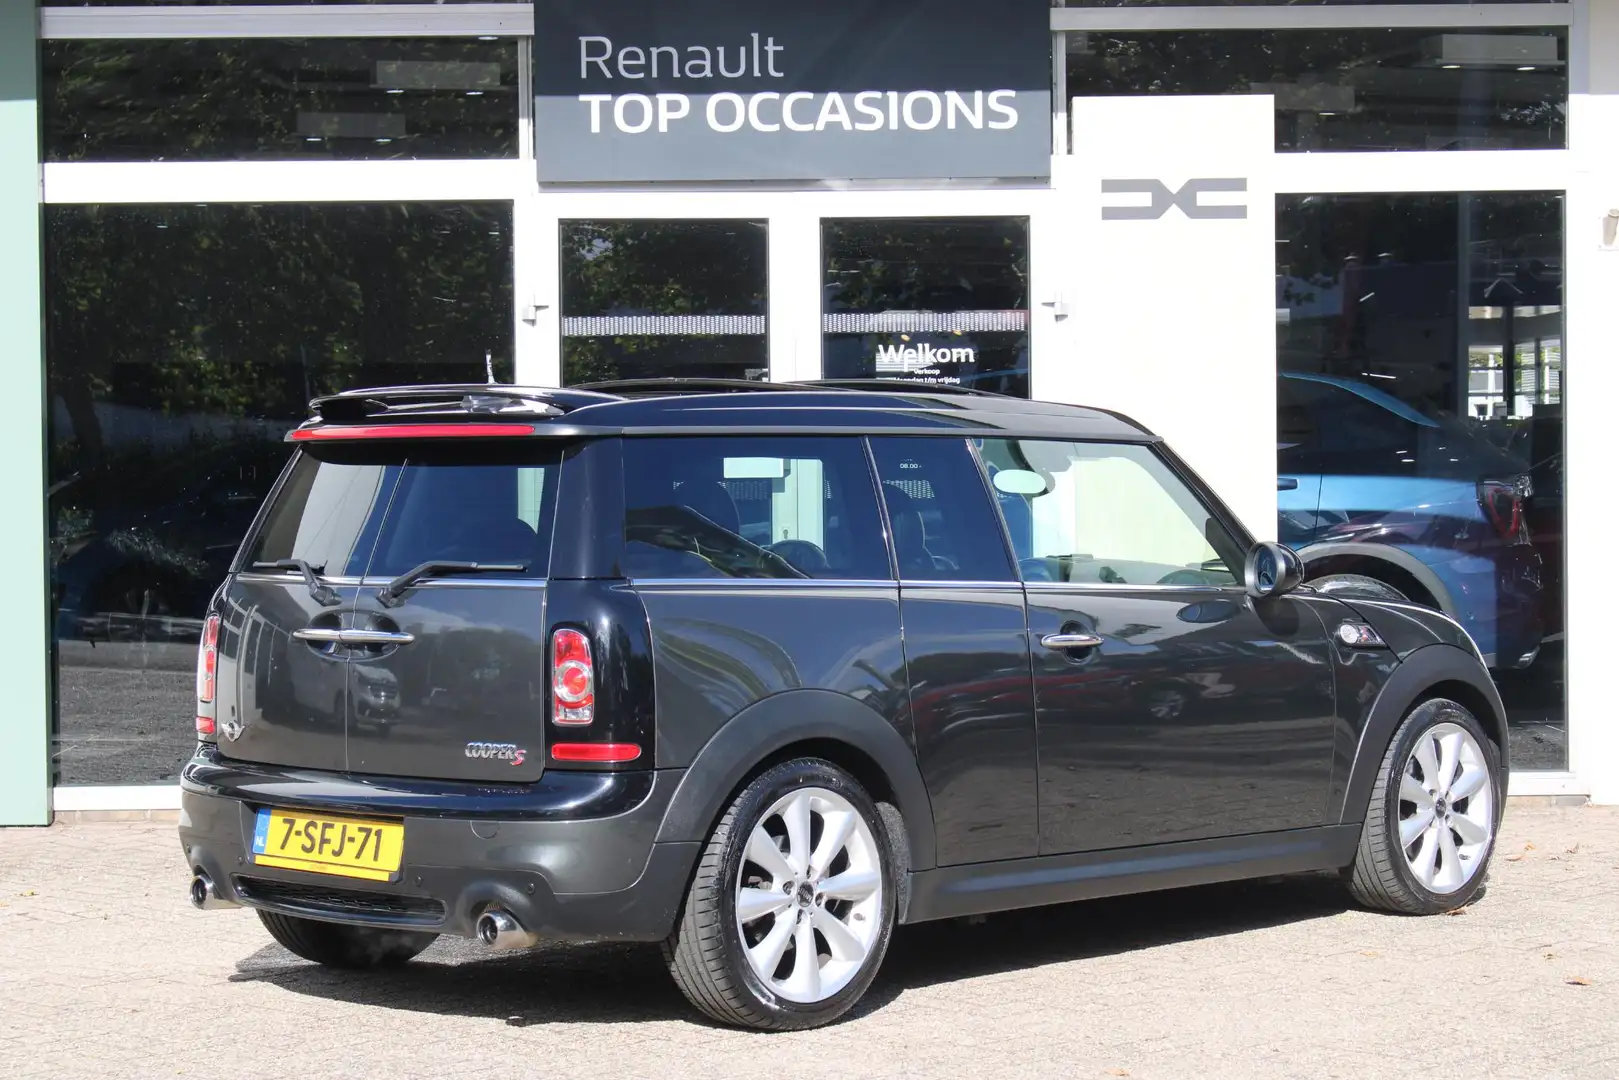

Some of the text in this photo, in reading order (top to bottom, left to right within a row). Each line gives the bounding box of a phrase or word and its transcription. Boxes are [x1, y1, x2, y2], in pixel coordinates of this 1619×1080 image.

[578, 32, 784, 79] Renault
[578, 89, 1019, 134] TOP OCCASIONS
[877, 342, 975, 363] Welkom
[937, 377, 960, 385] vrijdag
[464, 742, 527, 766] COOPER S
[254, 836, 265, 847] NL
[279, 817, 383, 862] 7-SFJ-71
